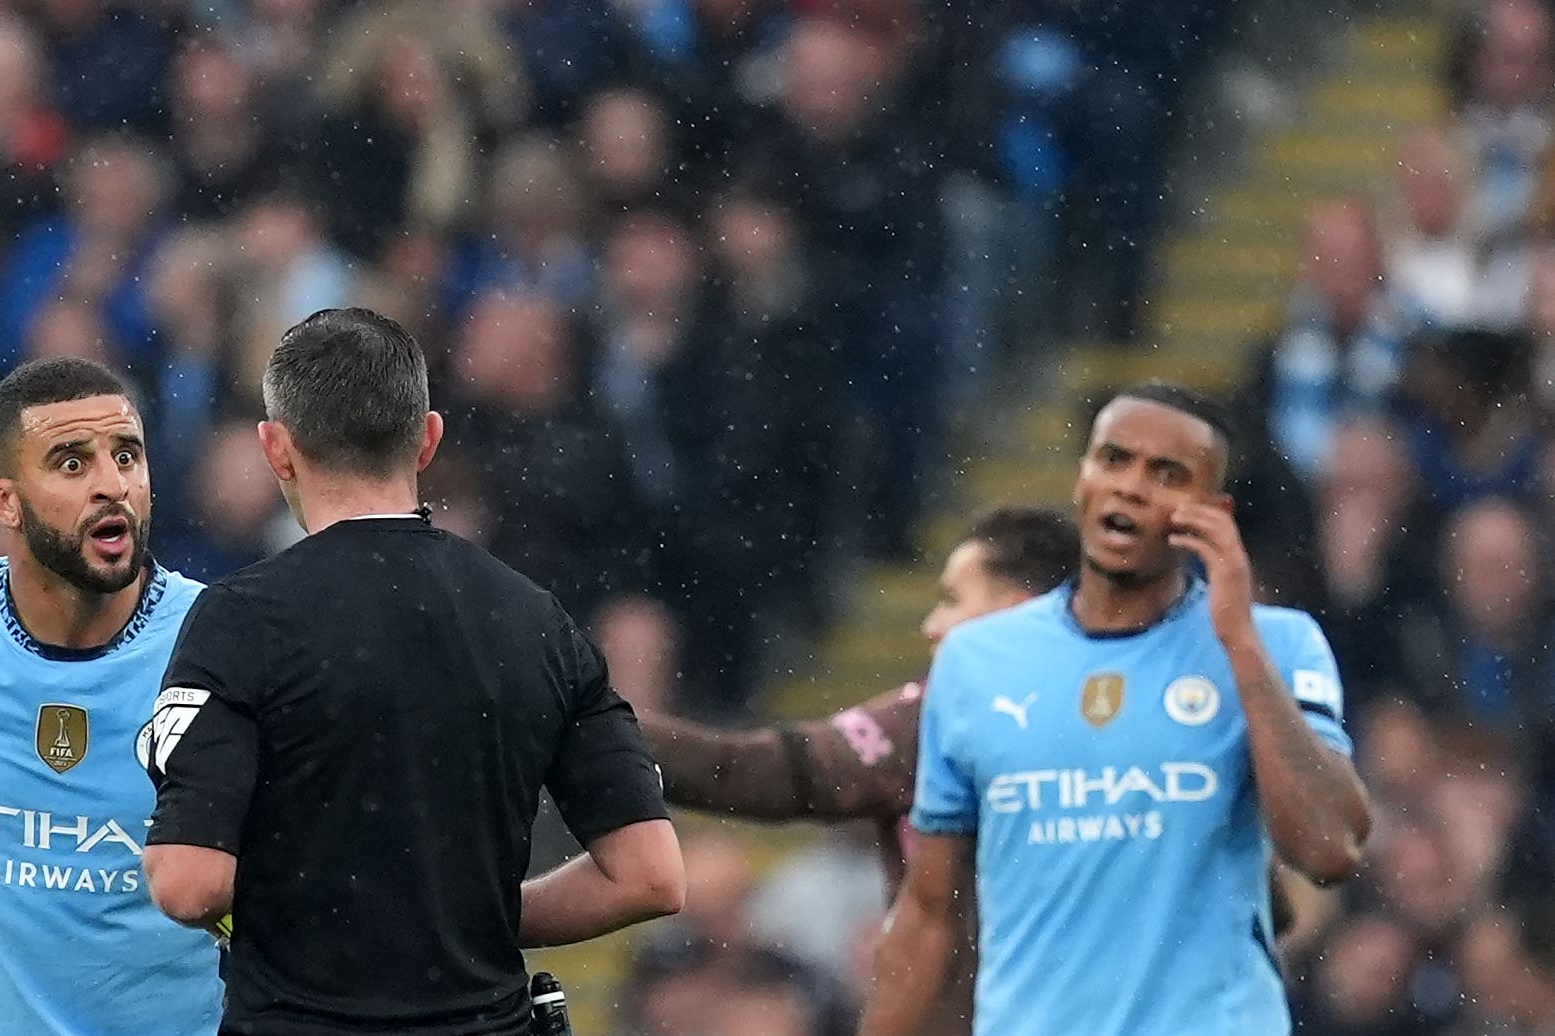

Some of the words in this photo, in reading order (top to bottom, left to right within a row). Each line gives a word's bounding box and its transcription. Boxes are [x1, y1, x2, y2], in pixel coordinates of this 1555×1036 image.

[49, 746, 74, 758] FIFA
[987, 762, 1218, 813] ETIHAD
[1027, 810, 1164, 846] AIRWAYS
